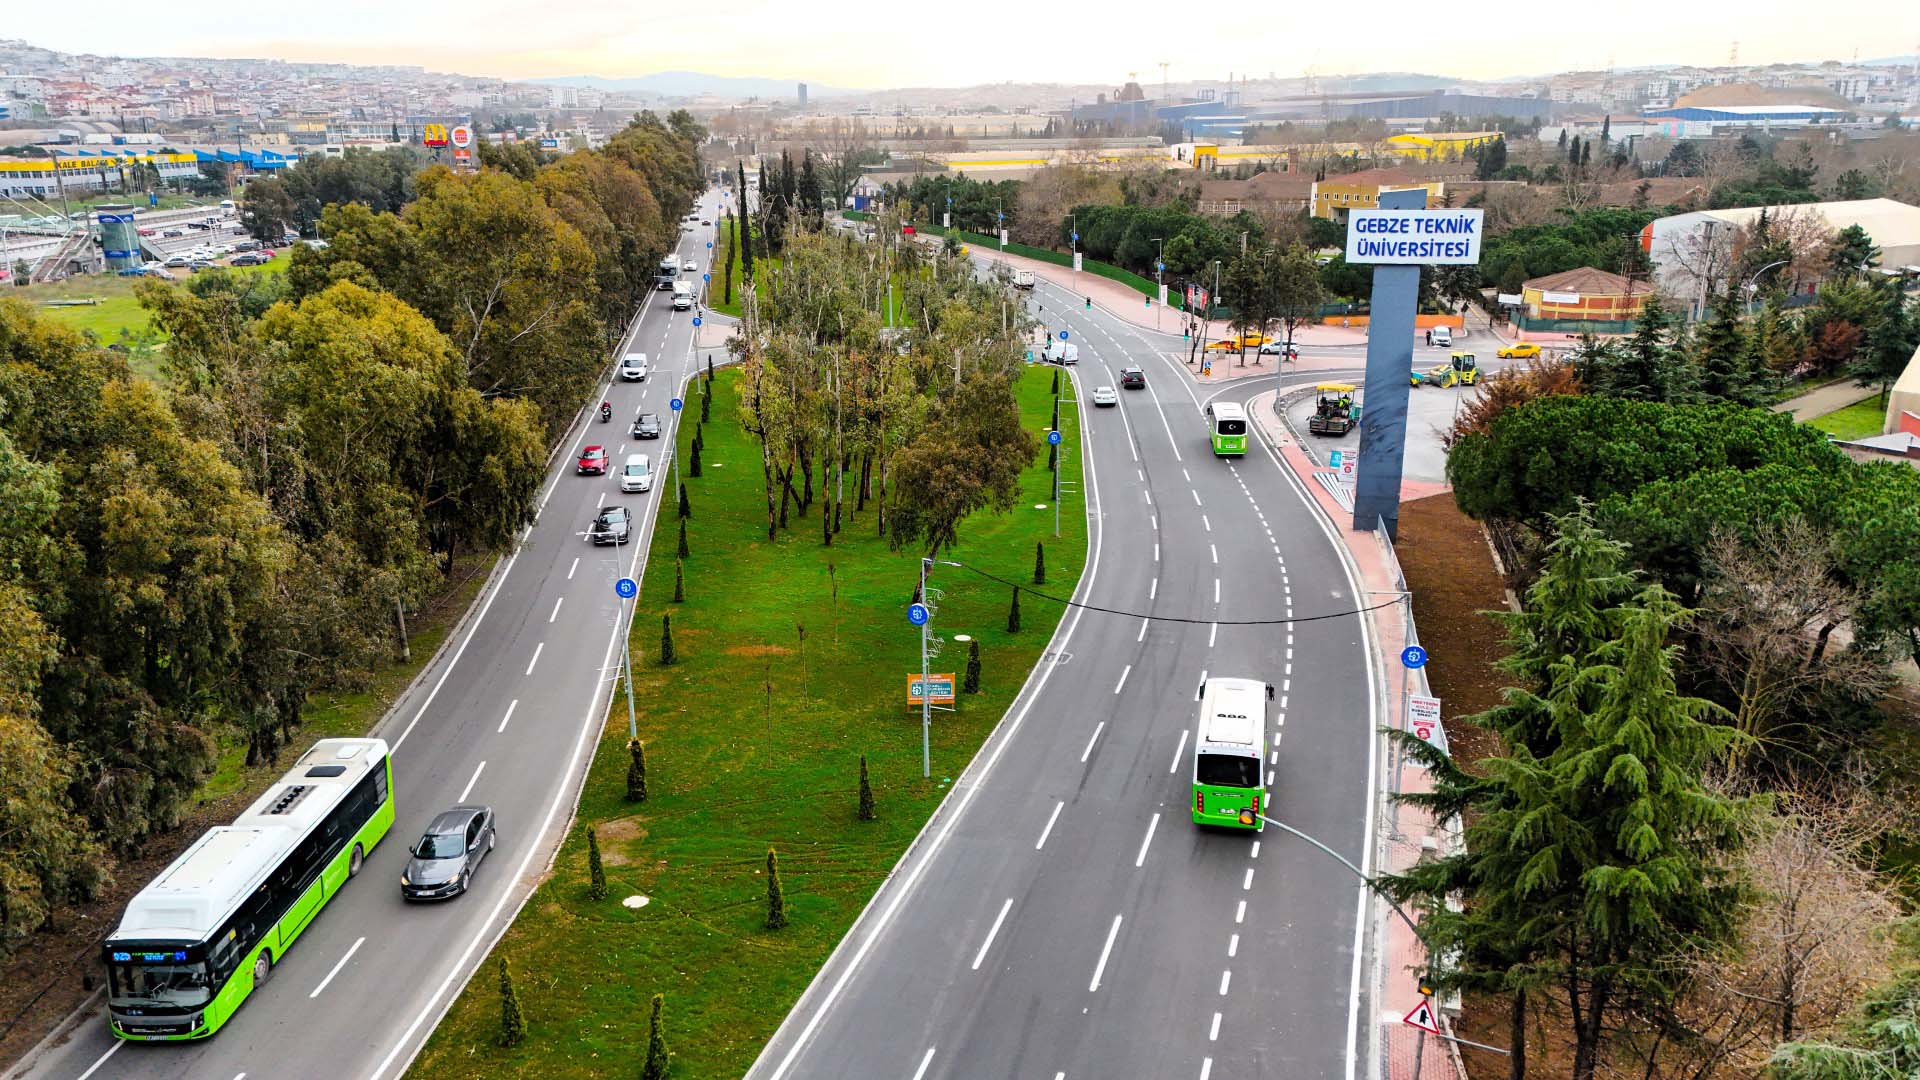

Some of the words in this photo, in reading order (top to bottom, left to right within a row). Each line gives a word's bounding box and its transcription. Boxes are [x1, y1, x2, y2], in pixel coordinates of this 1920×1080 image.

[1356, 217, 1410, 233] GEBZE
[1414, 214, 1476, 234] TEKNİK
[1357, 237, 1470, 257] ÜNİVERSİTESİ
